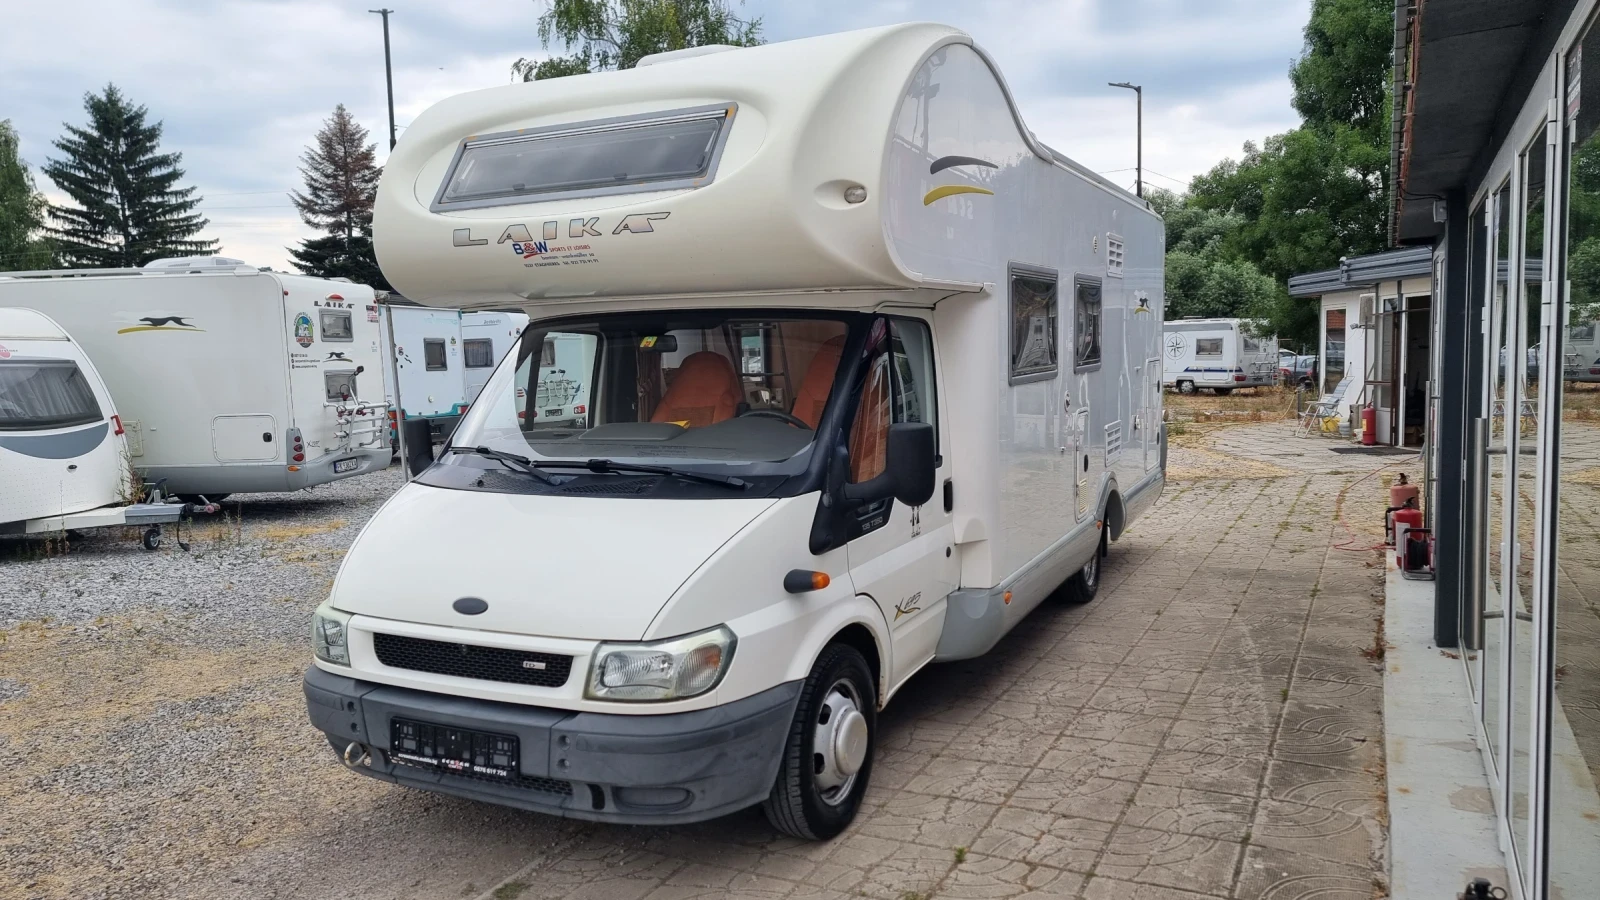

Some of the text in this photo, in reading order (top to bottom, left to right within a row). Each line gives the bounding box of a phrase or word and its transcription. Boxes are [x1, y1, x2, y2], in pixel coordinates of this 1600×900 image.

[452, 211, 671, 247] LAIKA
[512, 241, 548, 255] B&W
[314, 301, 355, 309] LAIKA
